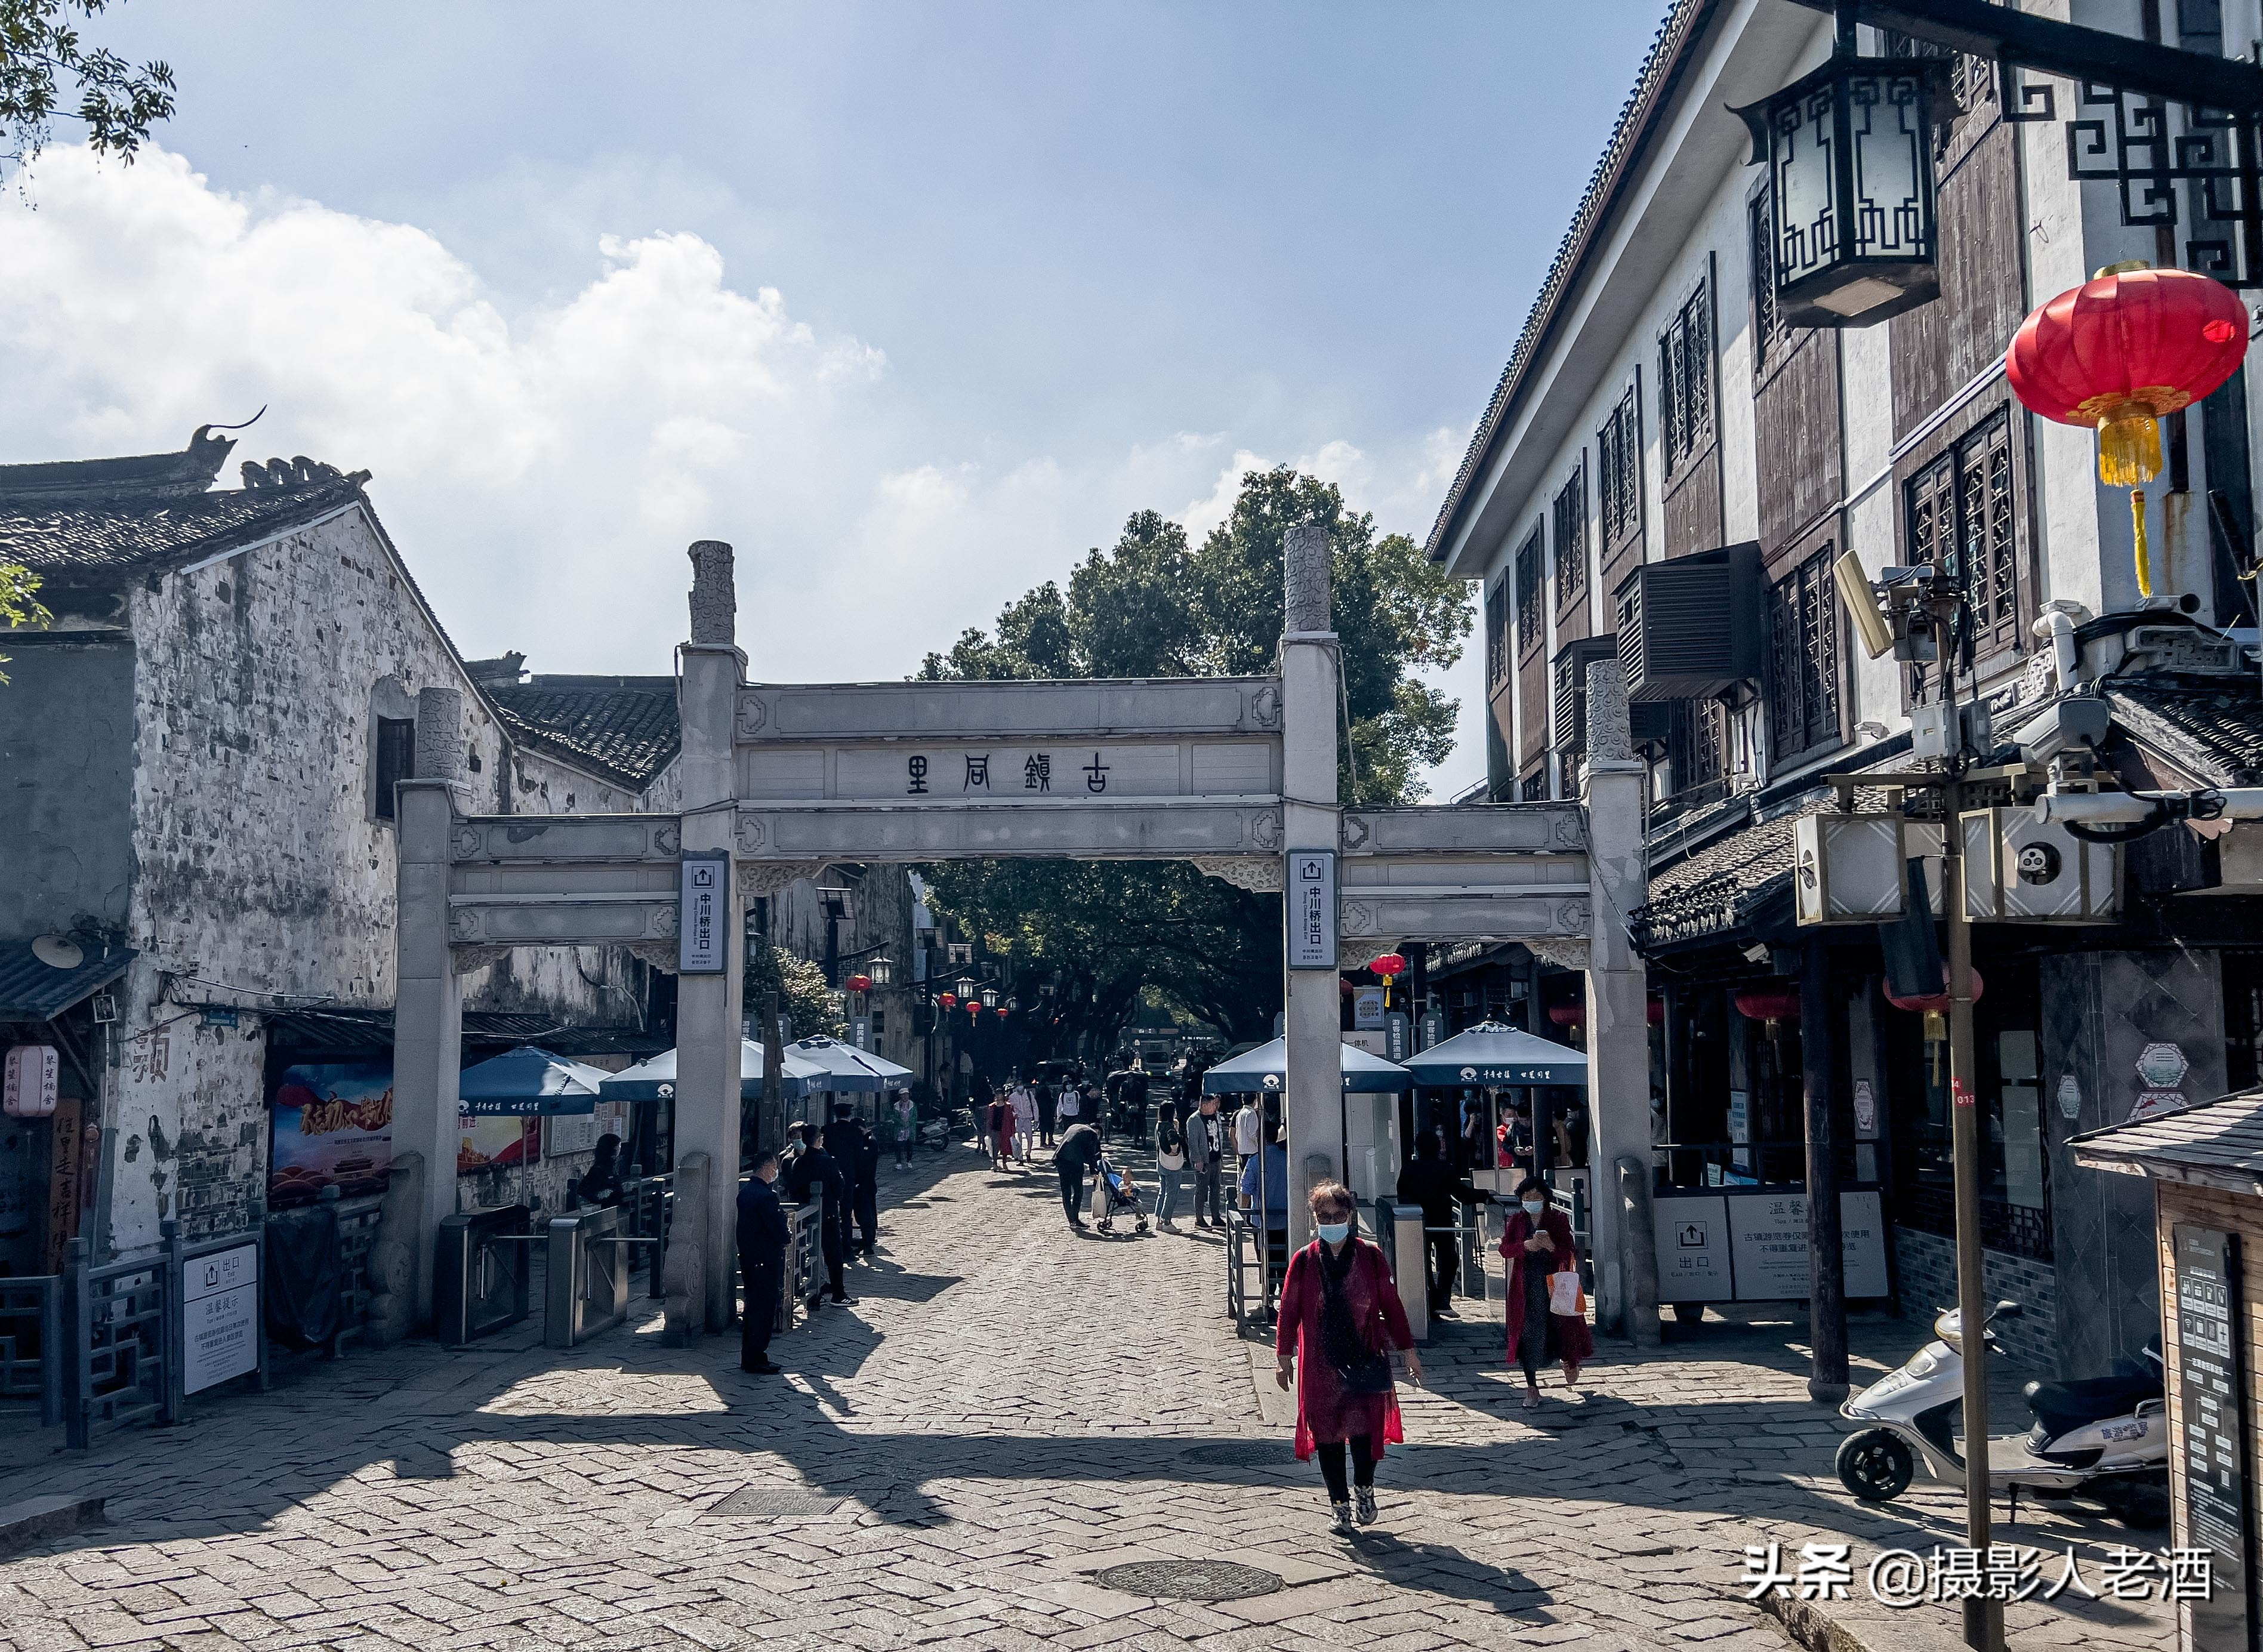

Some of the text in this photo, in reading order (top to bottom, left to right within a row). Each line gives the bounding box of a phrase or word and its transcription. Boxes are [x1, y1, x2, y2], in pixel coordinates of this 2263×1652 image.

[699, 892, 711, 950] 中川桥出口
[1309, 886, 1321, 945] 中川桥出口
[1392, 1019, 1401, 1059] 游客检票通道
[1427, 1019, 1435, 1049] 游客检票
[1957, 1095, 1975, 1104] 013
[1769, 1199, 1808, 1215] 温馨
[223, 1256, 239, 1271] 出口
[1679, 1256, 1709, 1268] 出口
[205, 1295, 239, 1316] 温馨提示
[2101, 1421, 2150, 1440] 旅游警察
